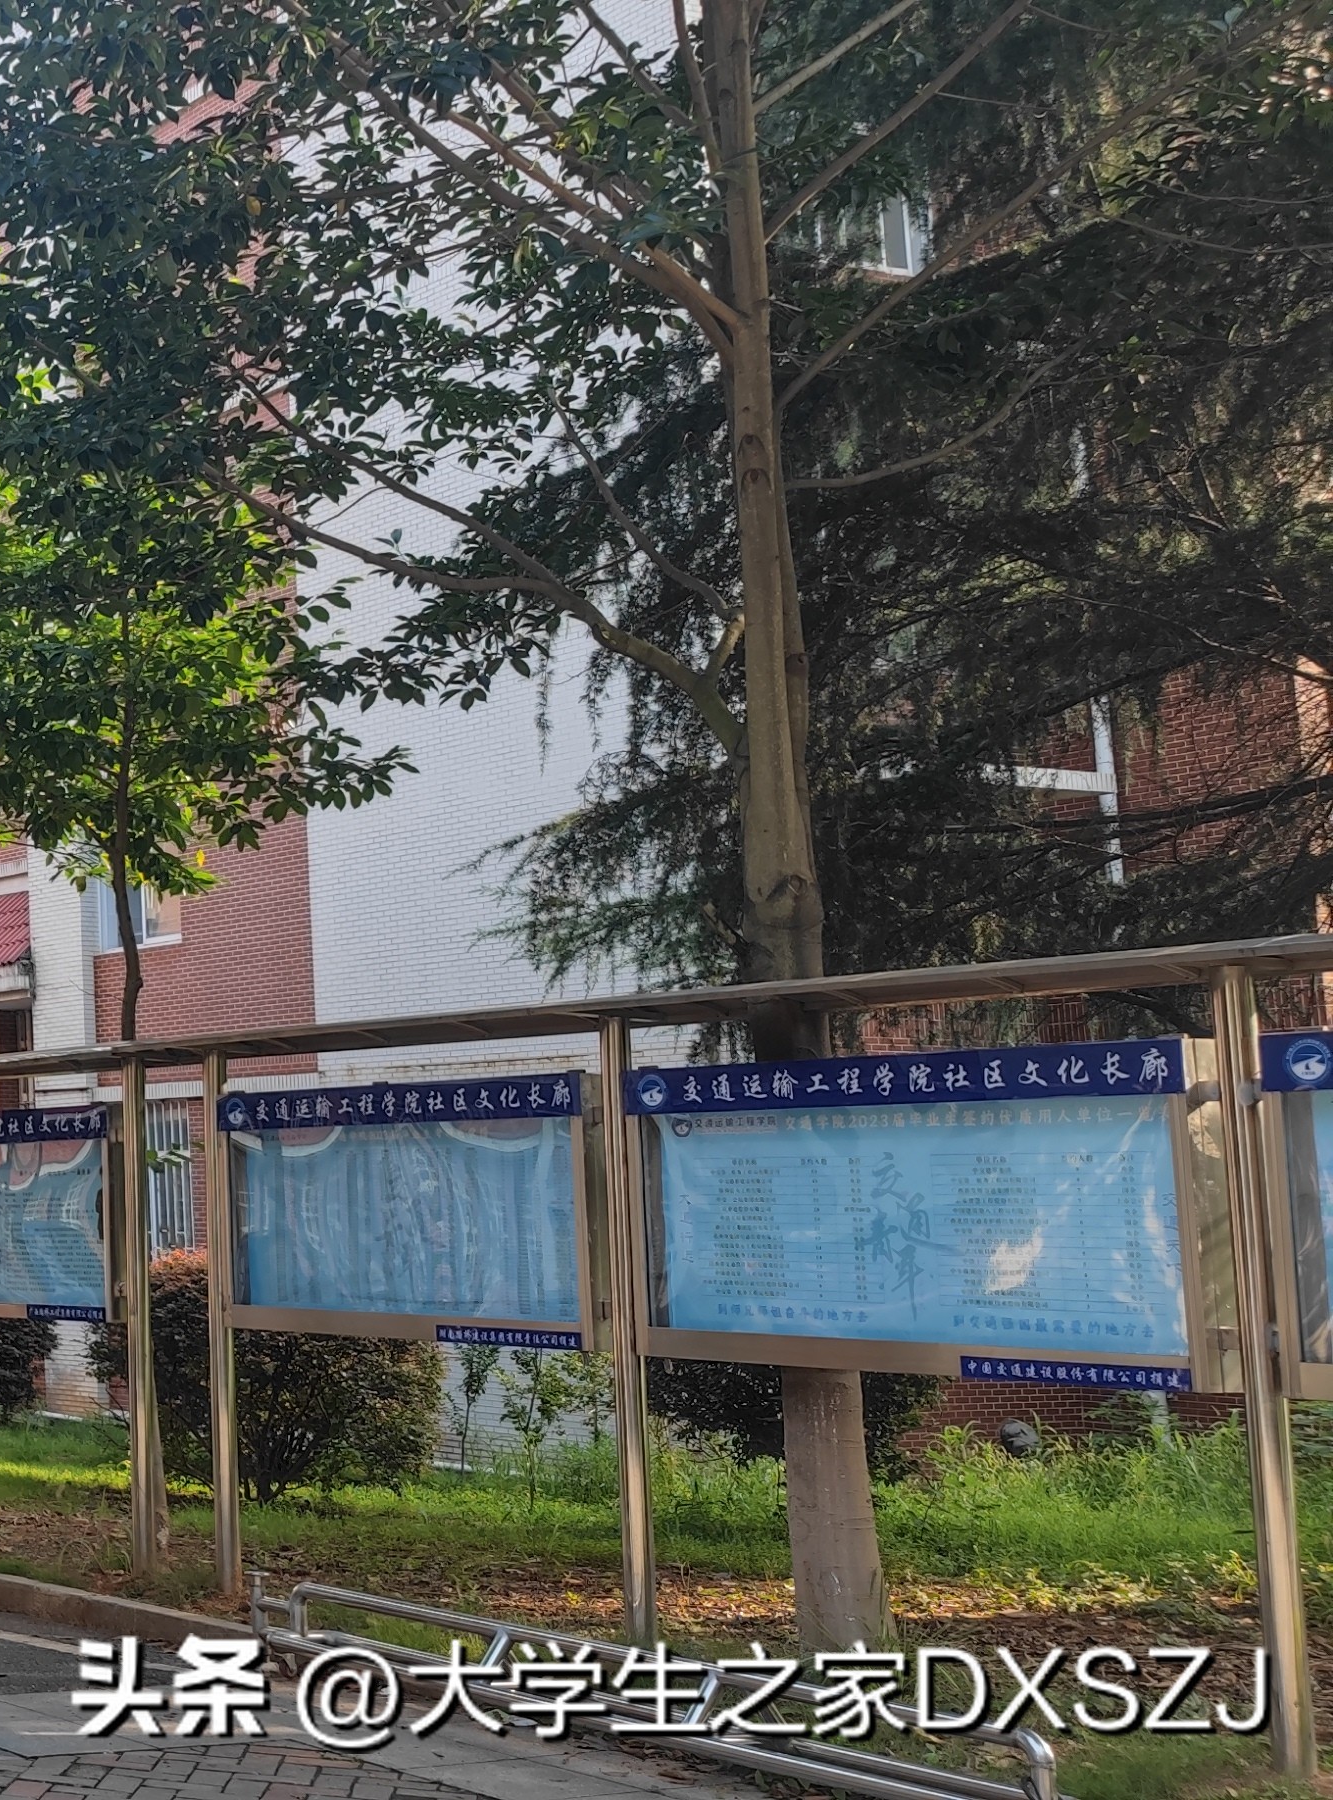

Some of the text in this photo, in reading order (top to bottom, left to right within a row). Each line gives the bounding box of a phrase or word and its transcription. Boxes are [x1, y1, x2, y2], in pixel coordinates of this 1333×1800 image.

[682, 1047, 1170, 1102] 交通运输工程学院社区文化长廊
[255, 1078, 571, 1121] 交通运输工程学院社区文化长廊
[967, 1359, 1182, 1389] 中国交通建设股份有限公司捐建
